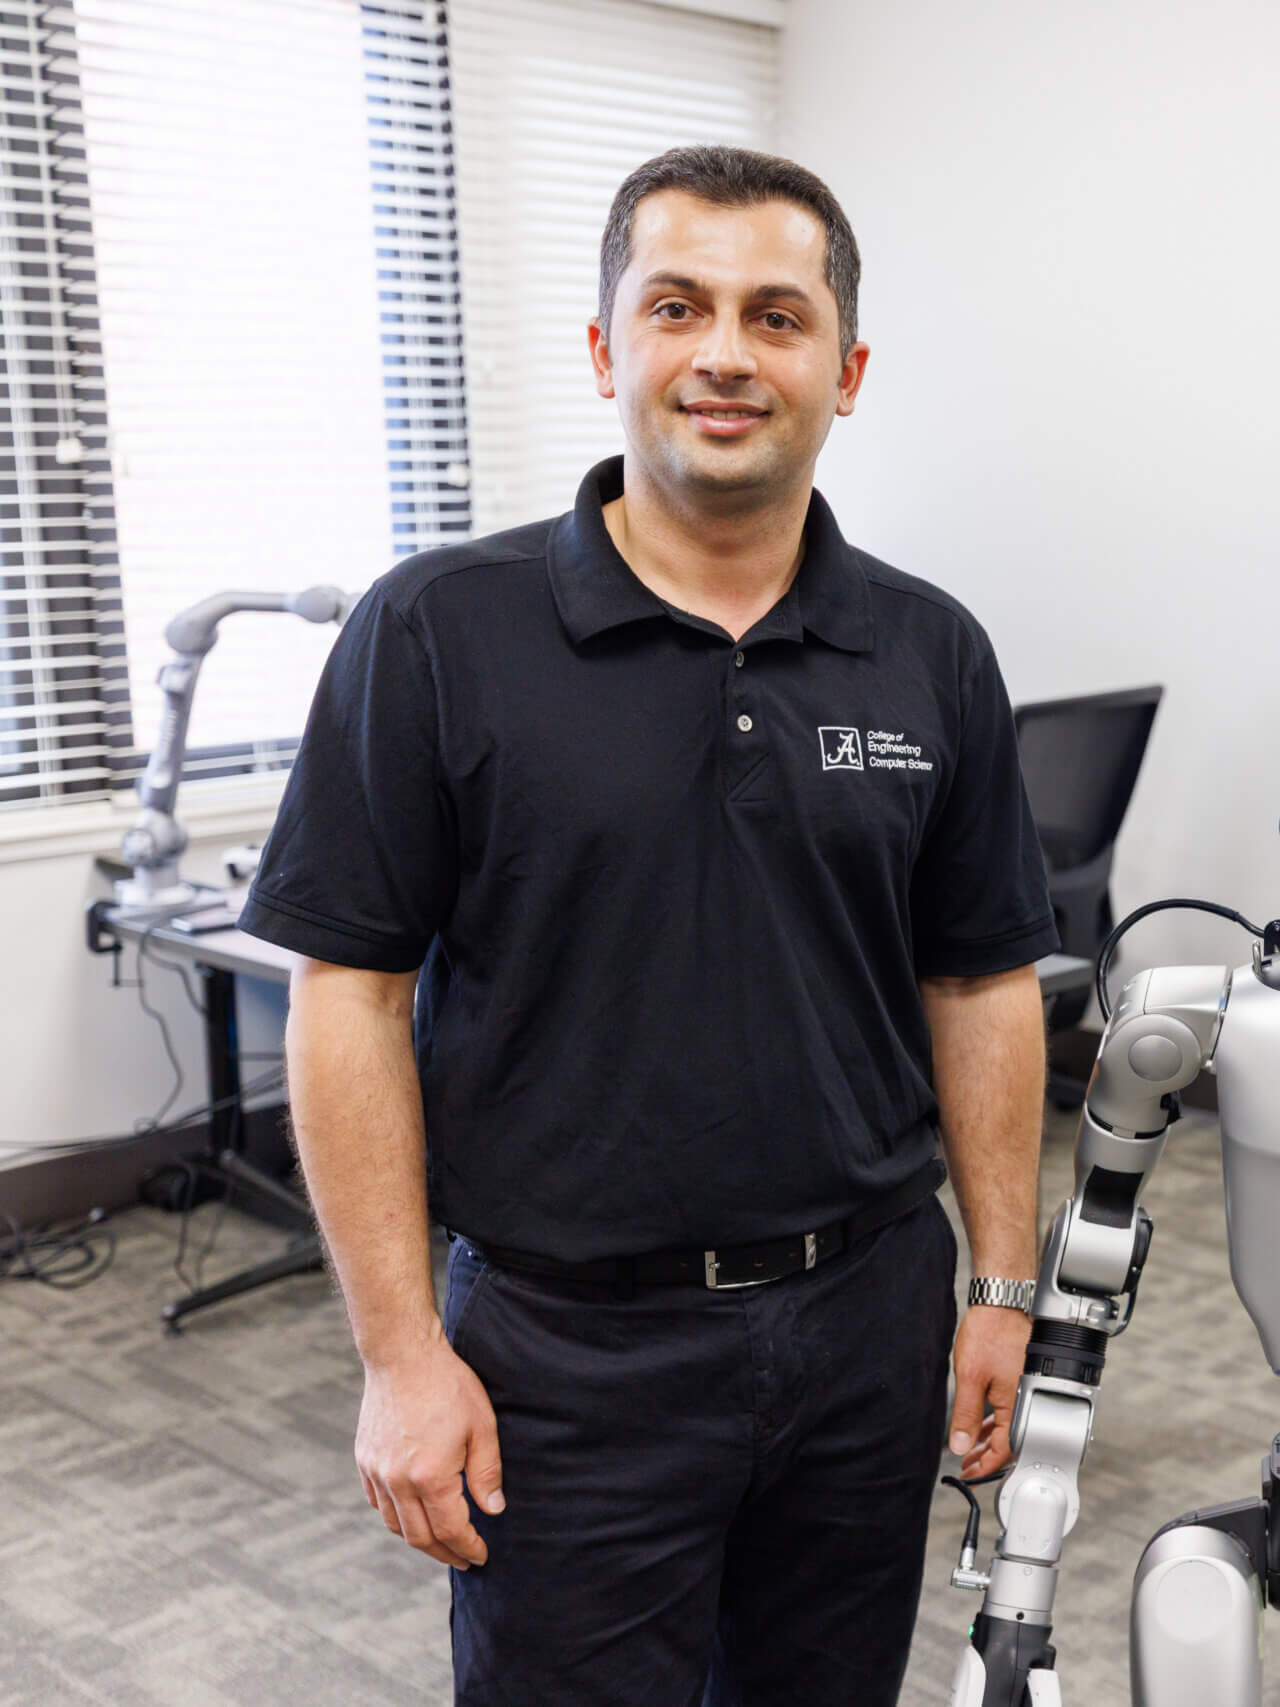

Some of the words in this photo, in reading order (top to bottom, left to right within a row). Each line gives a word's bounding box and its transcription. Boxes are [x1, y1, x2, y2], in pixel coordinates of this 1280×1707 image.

[867, 730, 895, 742] College
[896, 733, 904, 742] of
[868, 741, 921, 757] Engineering
[870, 756, 907, 770] Computer
